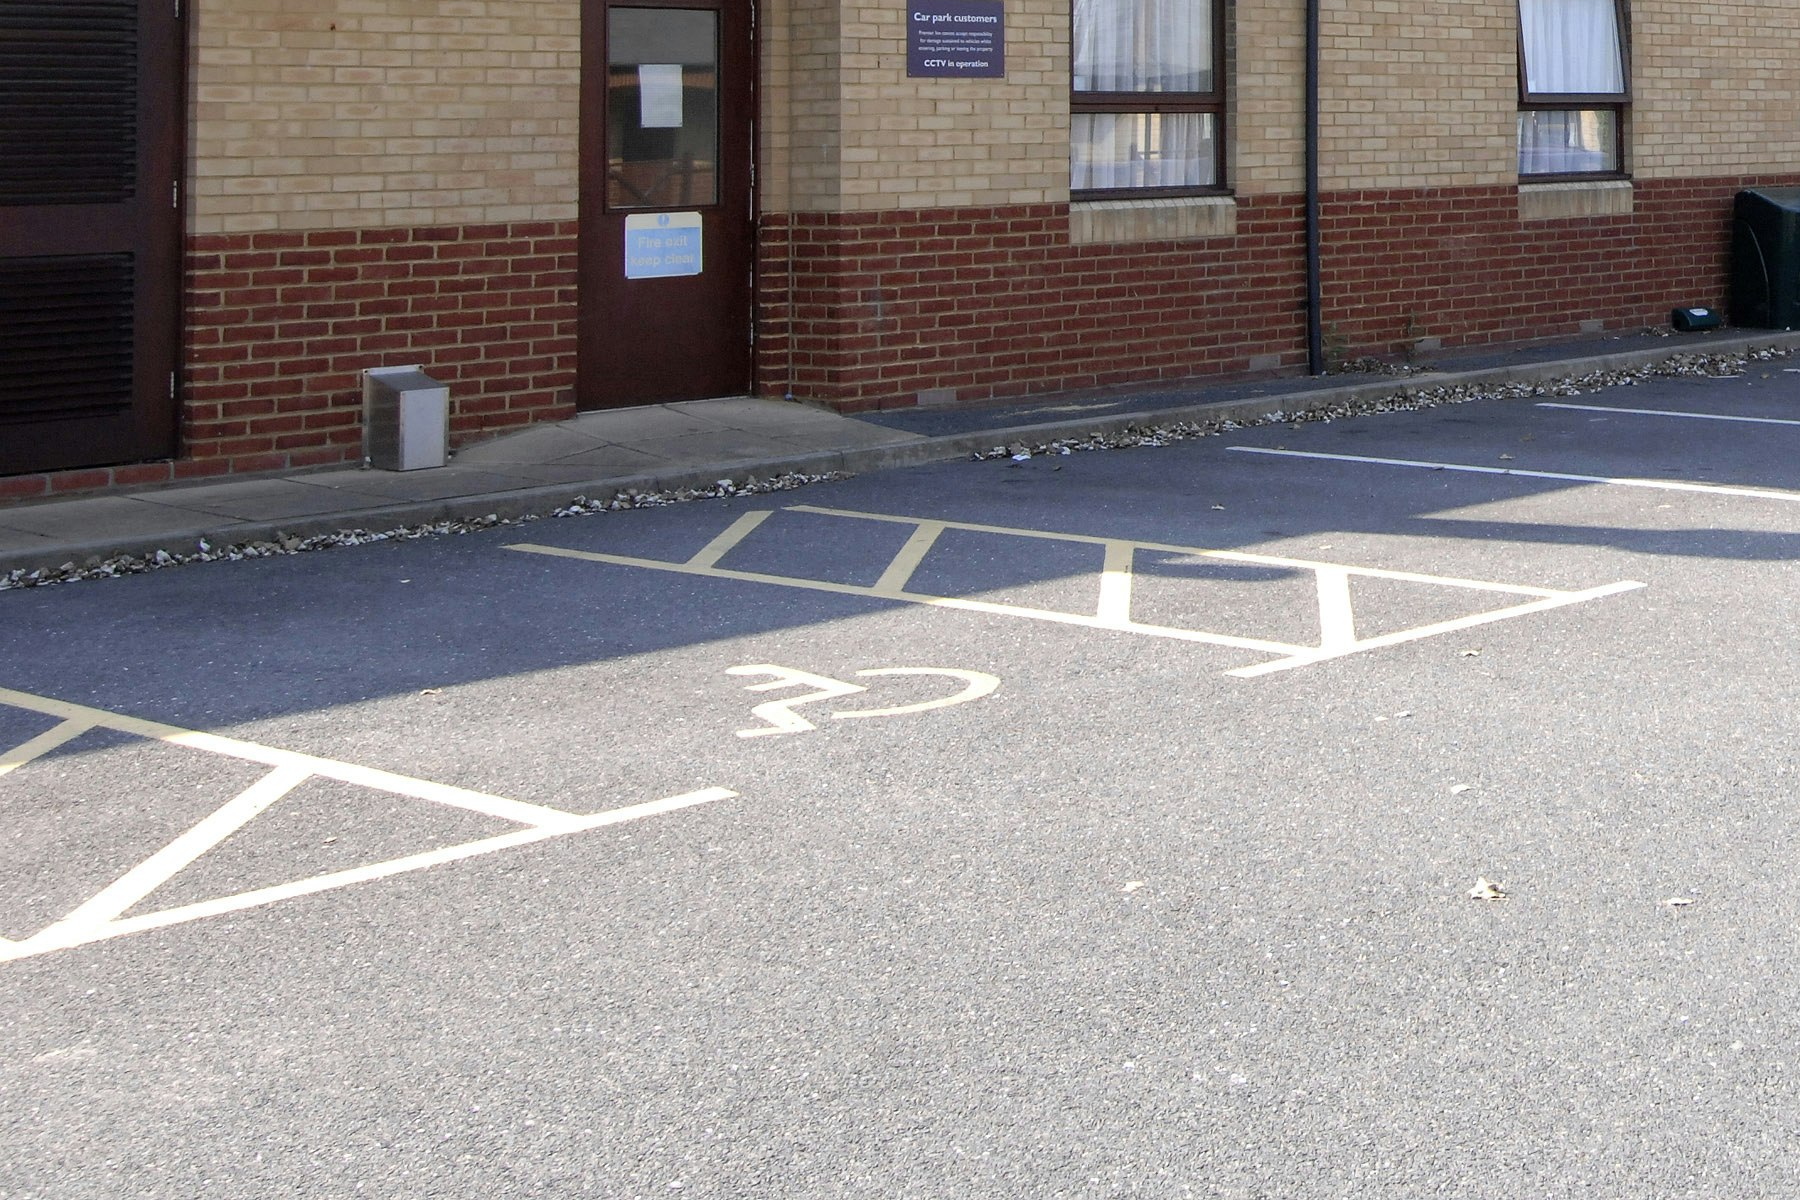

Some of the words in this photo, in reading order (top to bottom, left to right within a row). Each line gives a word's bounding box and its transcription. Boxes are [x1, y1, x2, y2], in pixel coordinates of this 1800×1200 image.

[913, 12, 930, 21] Car
[932, 13, 952, 24] park
[954, 15, 998, 23] customers
[924, 59, 947, 67] CCTV
[956, 60, 989, 69] operation
[638, 236, 661, 248] Fire
[665, 235, 688, 247] exit
[631, 256, 660, 267] keep
[664, 253, 694, 265] clear
